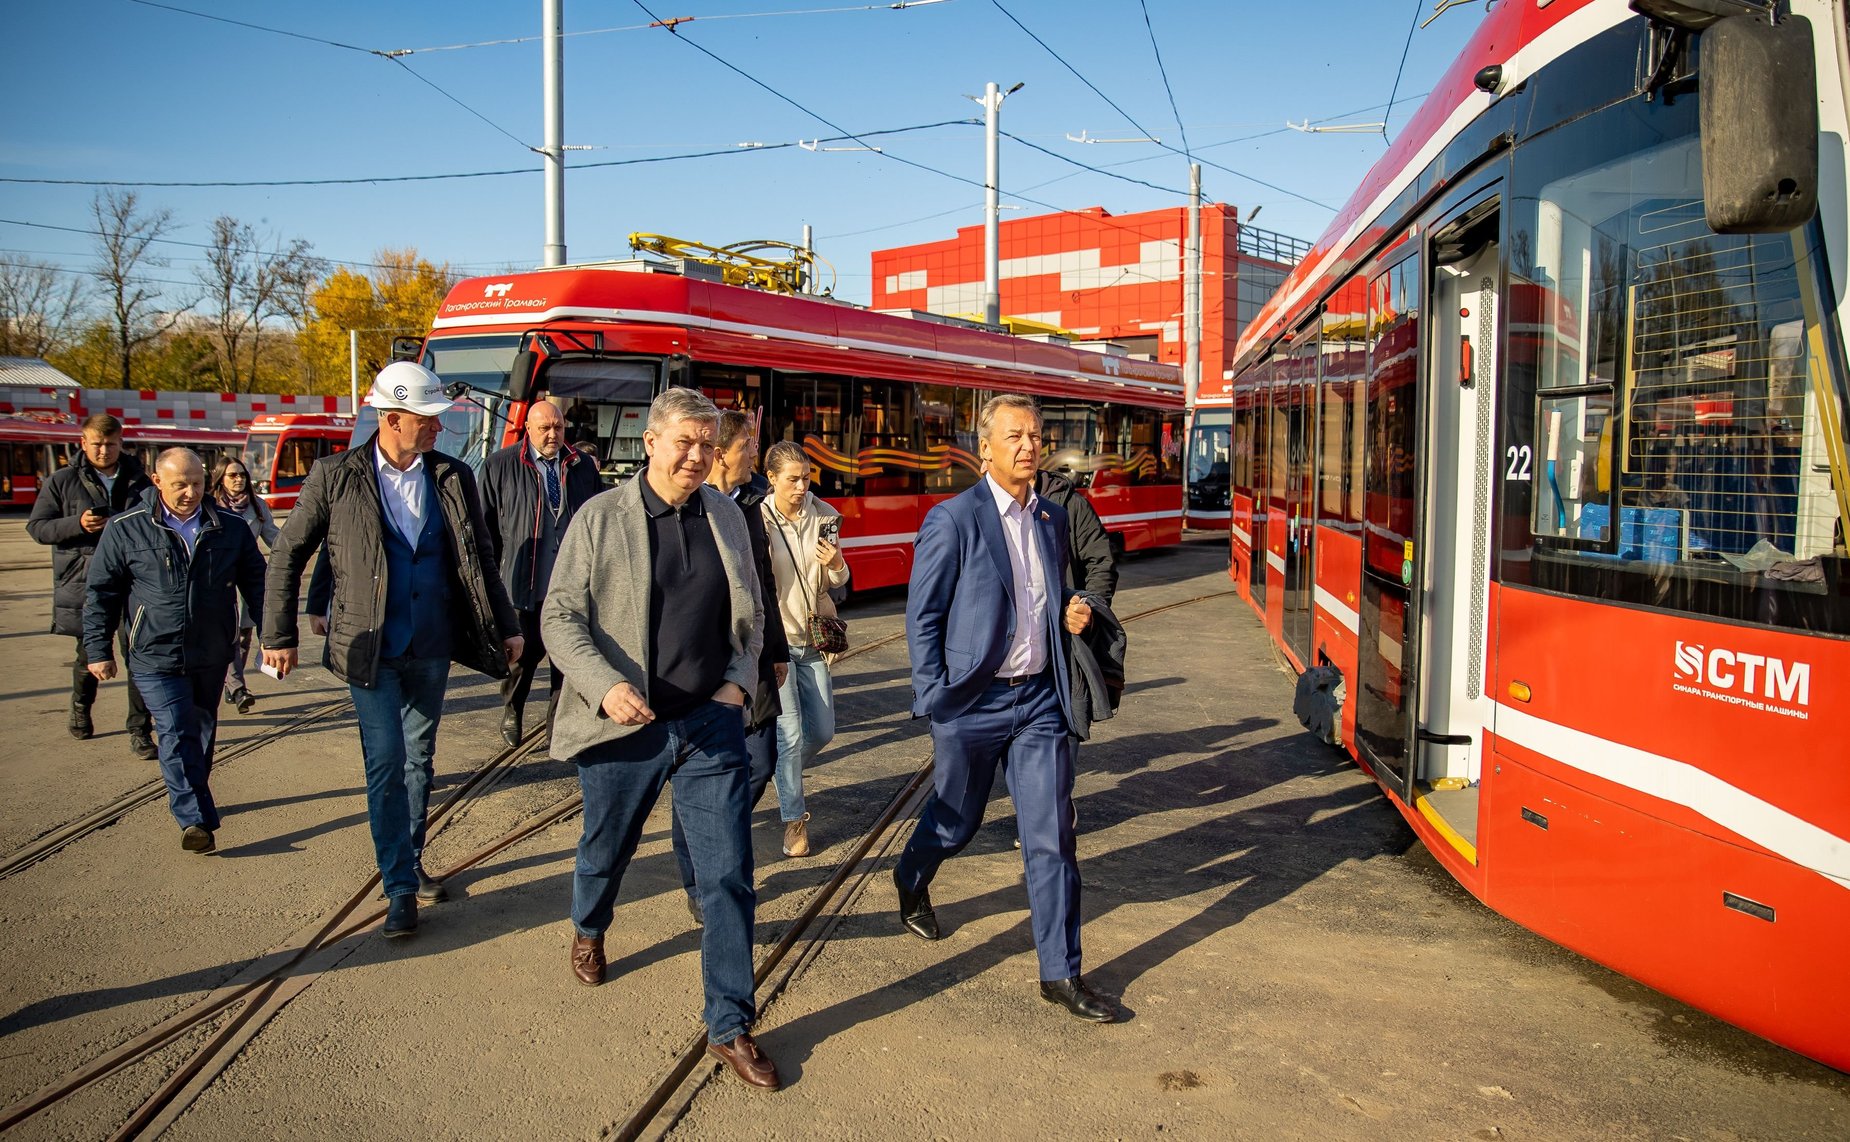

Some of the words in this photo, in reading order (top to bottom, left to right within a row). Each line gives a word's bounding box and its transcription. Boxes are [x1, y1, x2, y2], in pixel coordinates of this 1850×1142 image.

[445, 299, 501, 312] Таганрогский
[504, 297, 547, 309] Трамвай
[1506, 445, 1531, 480] 22
[1708, 648, 1810, 706] СТМ
[1673, 684, 1701, 696] СИНАРА
[1702, 690, 1764, 711] ТРАНСПОРТНЫЕ
[1765, 704, 1809, 720] МАШИНЫ
